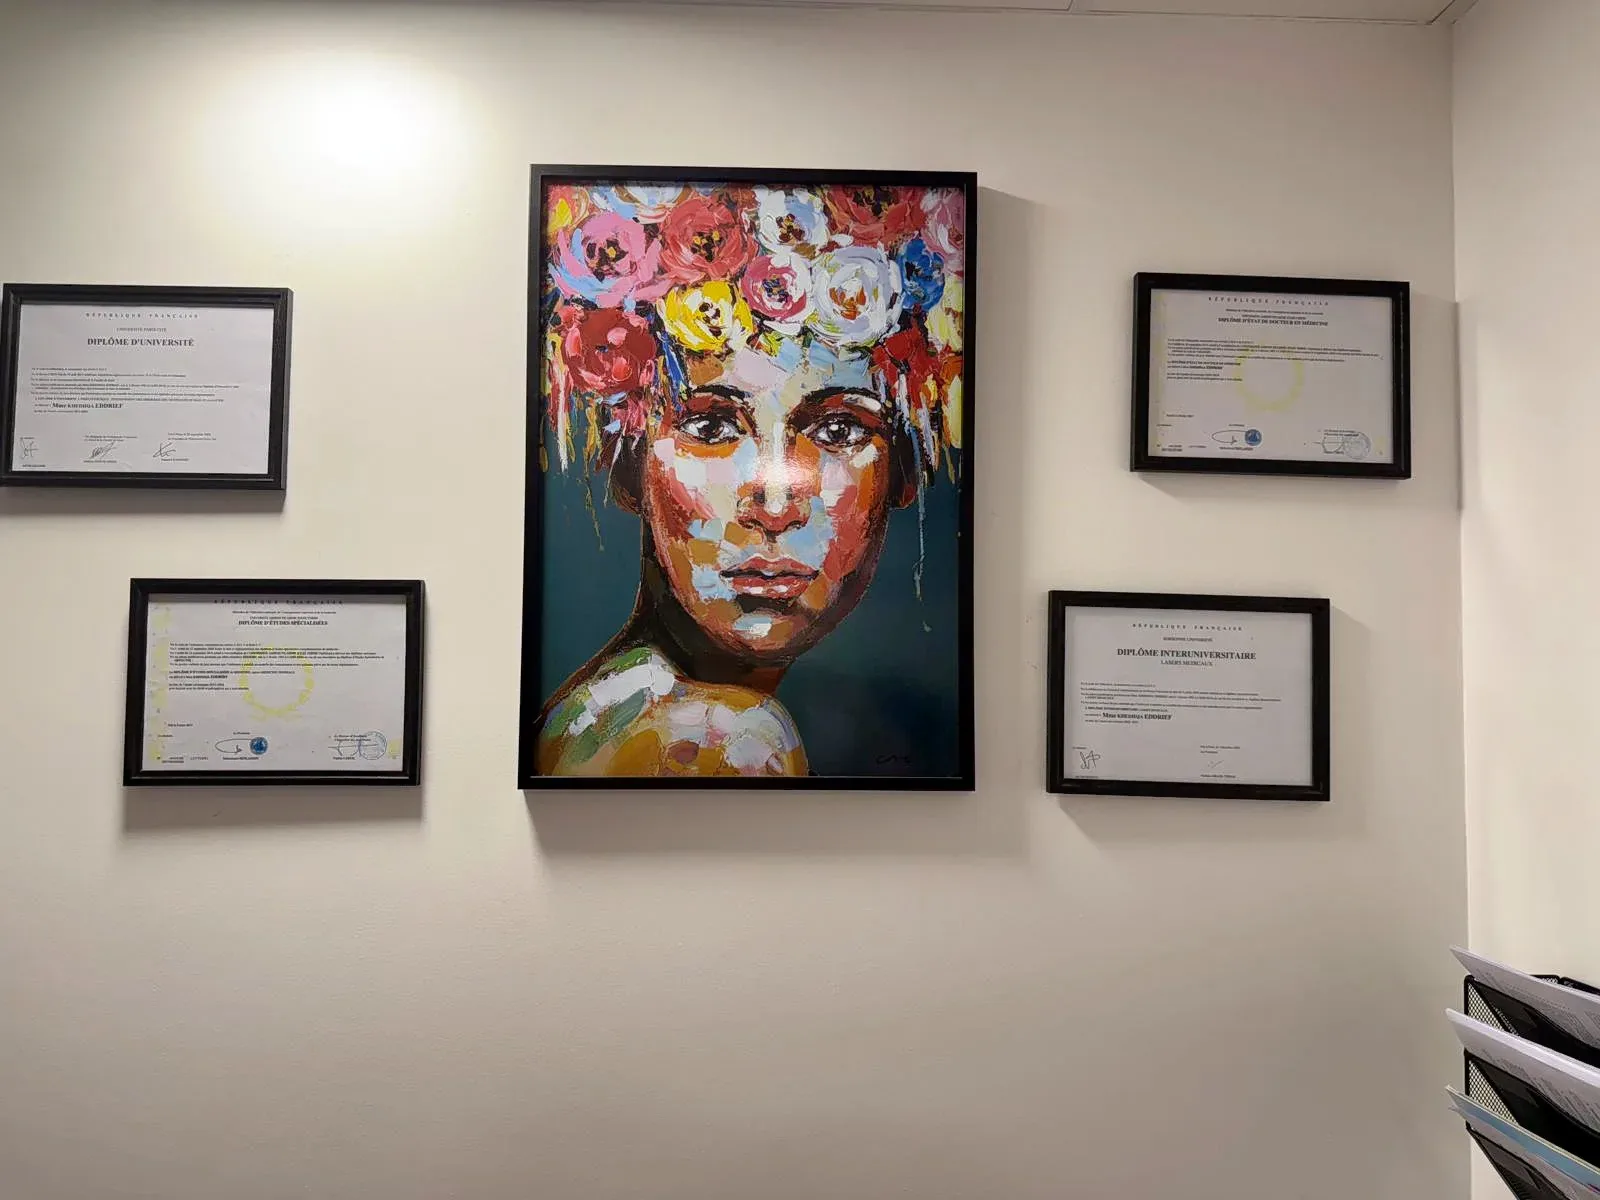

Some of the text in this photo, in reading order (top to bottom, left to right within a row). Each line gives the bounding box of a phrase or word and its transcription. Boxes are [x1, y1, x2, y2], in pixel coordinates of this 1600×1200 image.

[87, 336, 194, 347] DIPLÔME D'UNIVERSITÉ
[1117, 648, 1257, 660] DIPLÔME INTERUNIVERSITAIRE
